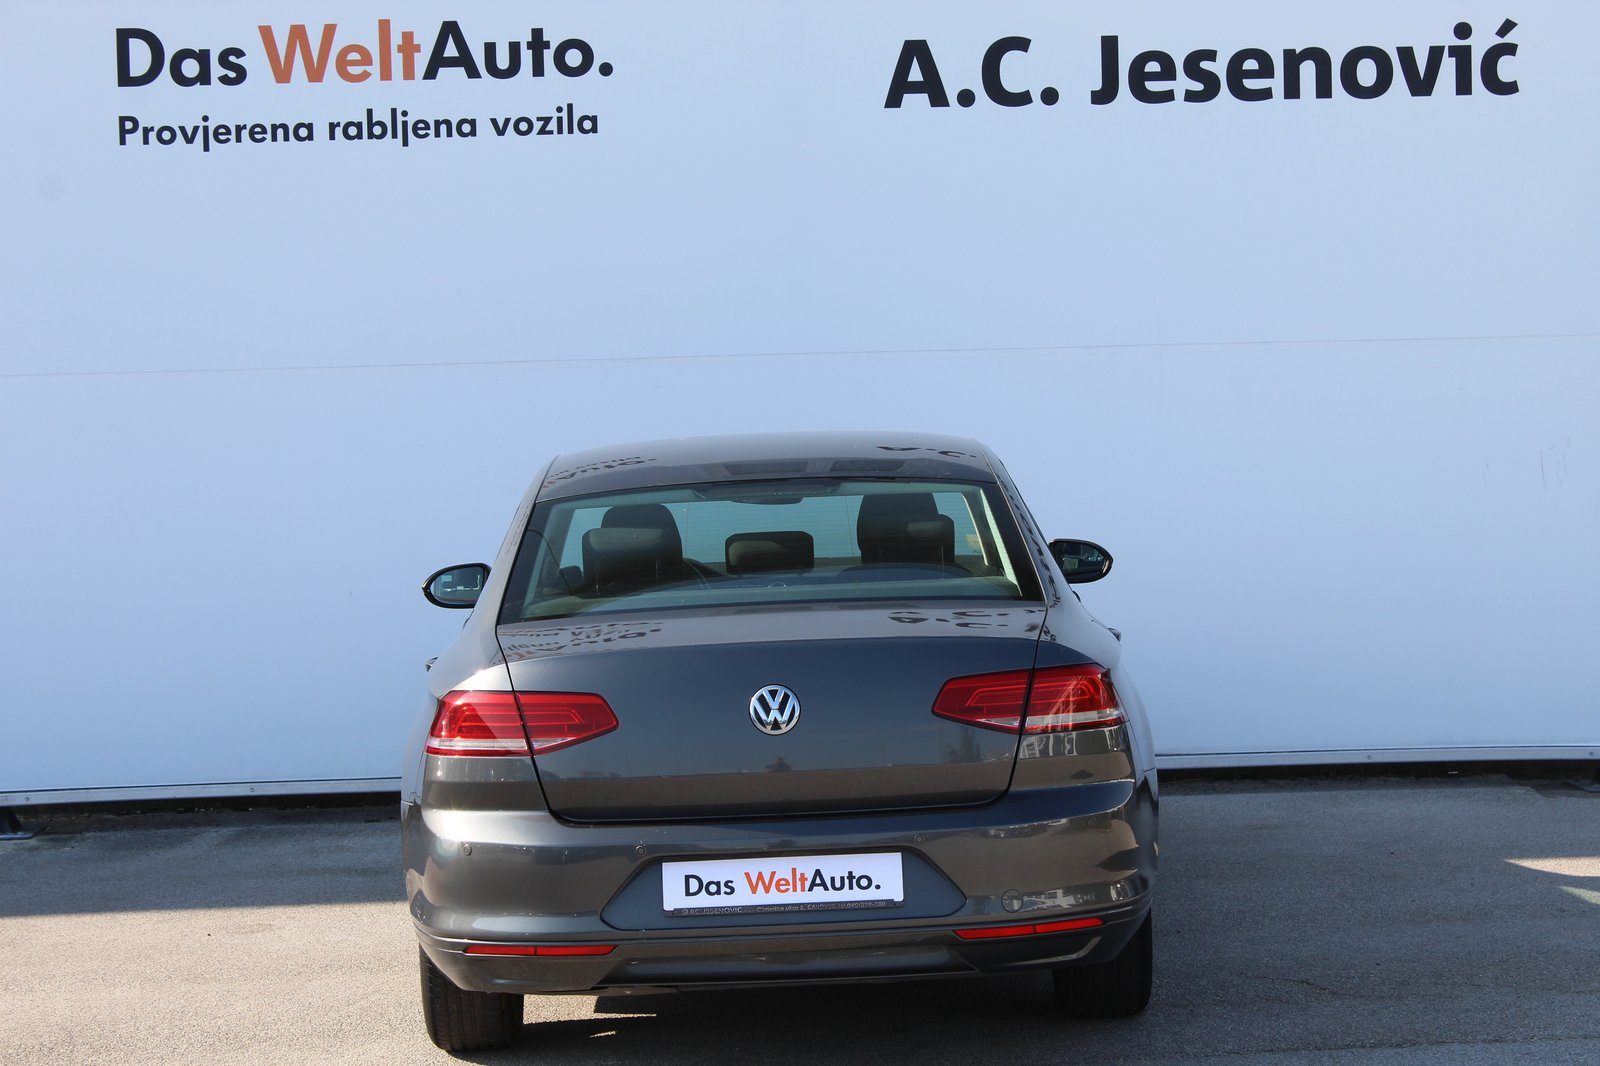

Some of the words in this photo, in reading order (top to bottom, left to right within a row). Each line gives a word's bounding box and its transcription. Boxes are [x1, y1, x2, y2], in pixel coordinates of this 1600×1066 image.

[115, 27, 248, 88] Das
[257, 18, 614, 84] WeltAuto.
[883, 35, 1060, 109] A.C.
[1090, 17, 1520, 106] Jesenović
[118, 114, 314, 153] Provjerena
[328, 107, 477, 148] rabljena
[489, 102, 599, 137] vozila
[684, 874, 736, 897] Das
[743, 867, 882, 895] WeltAuto.
